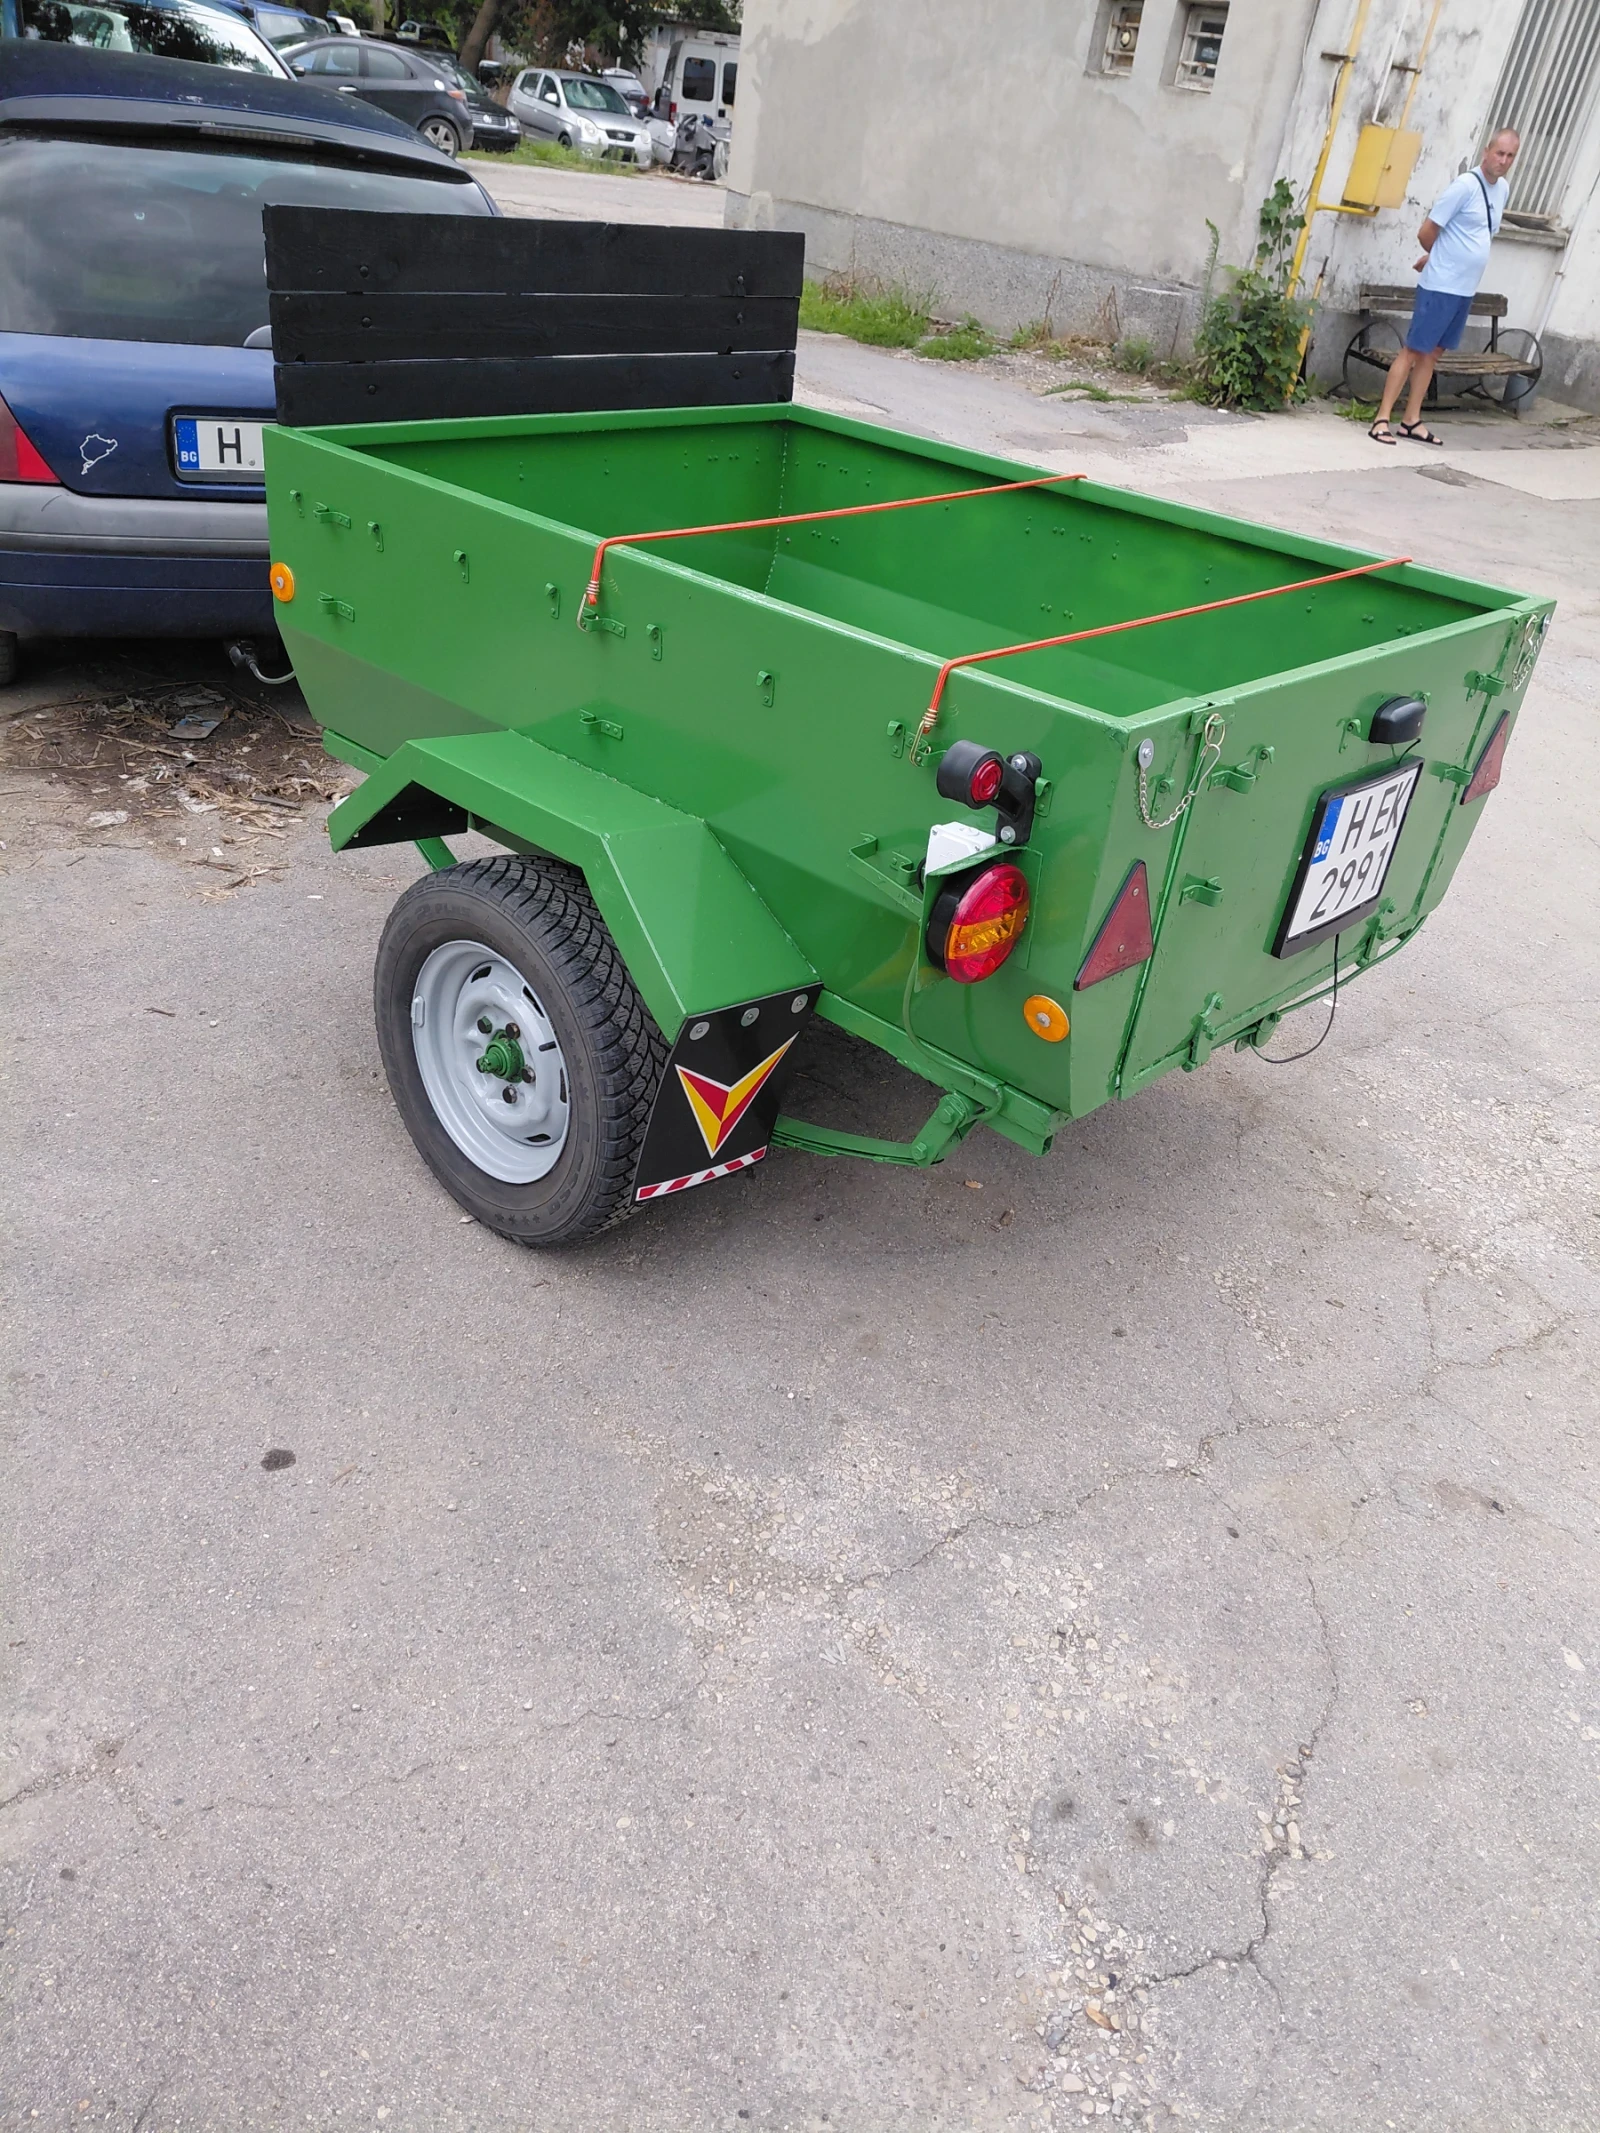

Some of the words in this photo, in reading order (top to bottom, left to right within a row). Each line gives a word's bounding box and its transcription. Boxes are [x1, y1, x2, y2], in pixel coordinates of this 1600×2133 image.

[180, 451, 198, 463] BG
[217, 427, 242, 464] H
[1313, 839, 1331, 858] BG
[1309, 840, 1390, 922] 2991
